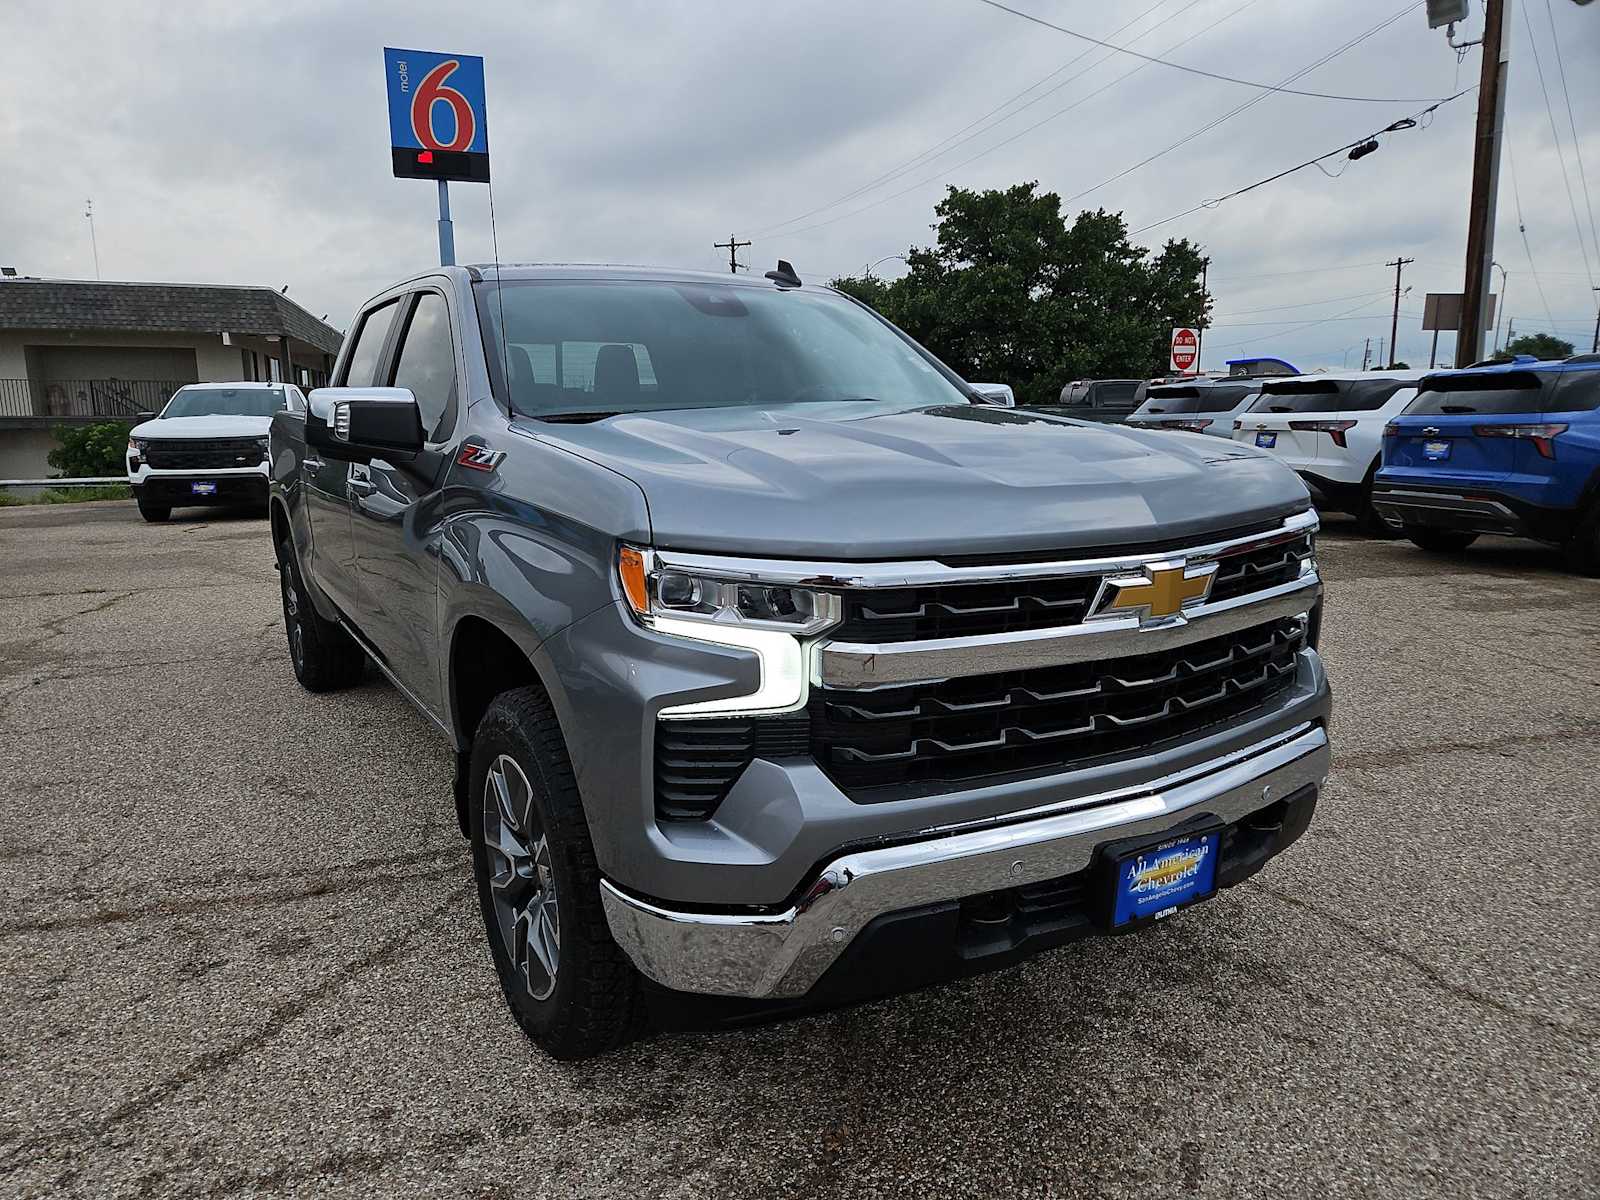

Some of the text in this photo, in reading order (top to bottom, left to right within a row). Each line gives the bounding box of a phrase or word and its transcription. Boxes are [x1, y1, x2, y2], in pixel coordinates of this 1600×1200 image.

[397, 61, 409, 93] motel
[410, 59, 476, 152] 6
[1175, 336, 1195, 345] DO NOT
[1175, 355, 1192, 363] ENTER
[458, 443, 507, 472] Z71
[1127, 844, 1209, 879] All American
[1137, 864, 1199, 893] Chevrolet
